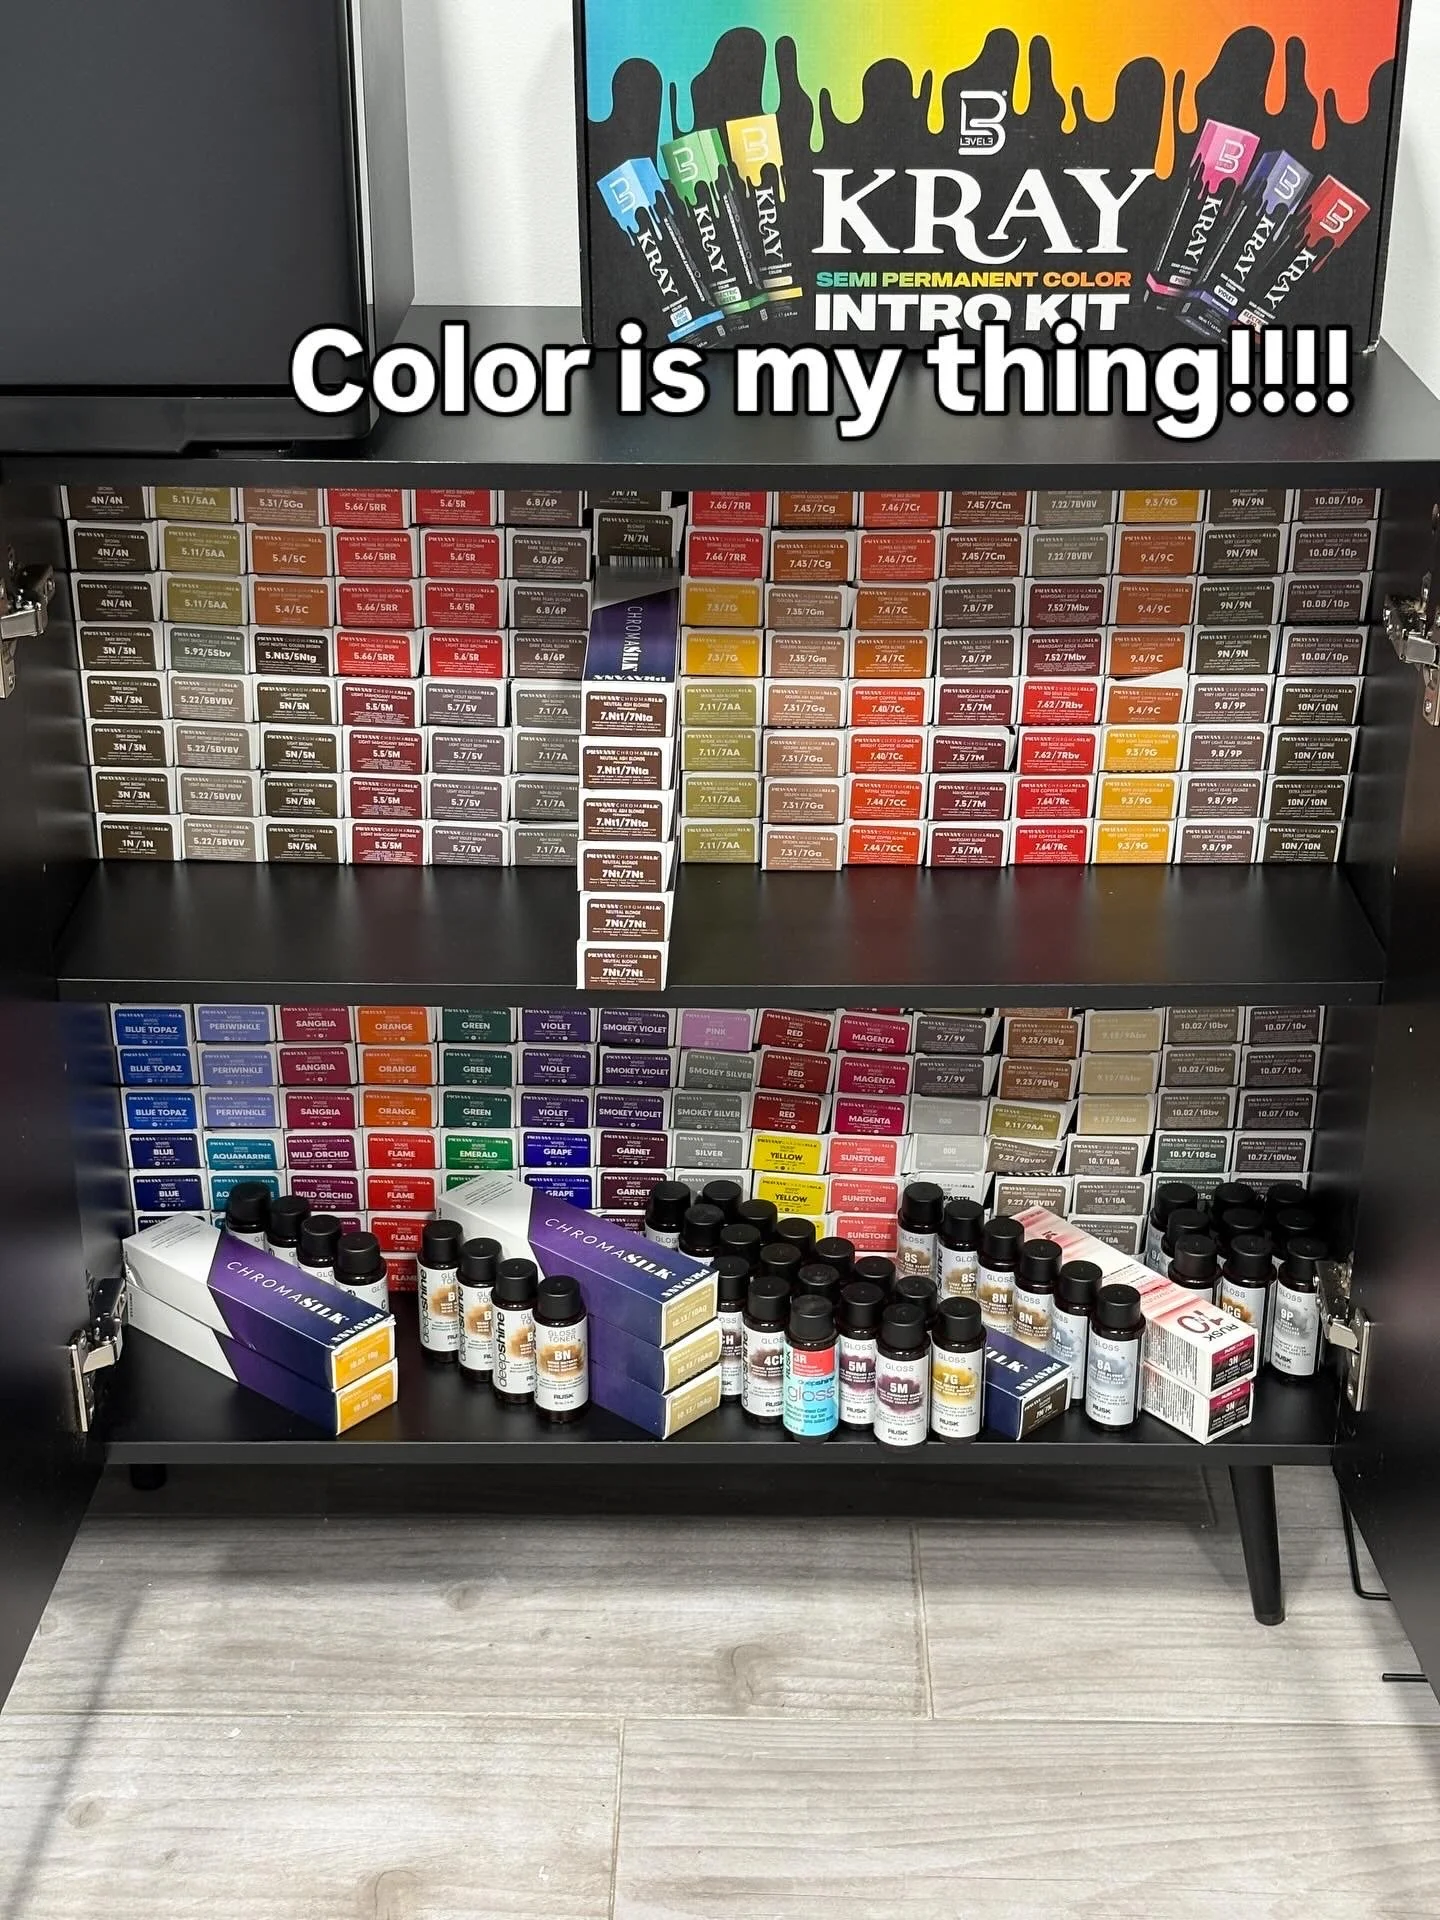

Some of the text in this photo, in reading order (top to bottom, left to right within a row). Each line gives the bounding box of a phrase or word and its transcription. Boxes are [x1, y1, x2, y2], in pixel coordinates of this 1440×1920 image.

[812, 168, 1155, 265] KRAY
[756, 186, 784, 260] KRAY
[1185, 195, 1223, 264] KRAY
[694, 204, 729, 274] KRAY
[1234, 215, 1276, 283] KRAY
[637, 229, 680, 296] KRAY
[816, 272, 1131, 287] SEMI PERMANENT COLOR
[1264, 247, 1317, 309] KRAY
[815, 294, 1129, 330] INTRO KIT
[1232, 498, 1264, 506] 9N/9N
[623, 534, 649, 543] 7N/7N
[97, 549, 129, 557] 4N/4N
[1226, 548, 1258, 557] 9N/9N
[533, 556, 564, 564] 6.8/6P
[1141, 553, 1174, 562] 9.4/9C
[101, 599, 132, 608] 4N/4N
[878, 606, 908, 615] 7.4/7C
[535, 653, 565, 661] 6.8/6P
[1217, 650, 1248, 658] 9N/9N
[699, 702, 741, 711] 7.11/7AA
[959, 703, 992, 712] 7.5/7M
[1214, 702, 1246, 710] 9.8/9P
[1298, 703, 1338, 712] 10N/10N
[285, 751, 315, 760] 5N/5N
[699, 748, 740, 757] 7.11/7AA
[1211, 749, 1242, 758] 9.8/9P
[1294, 751, 1334, 760] 10N/10N
[287, 842, 317, 850] 5N/5N
[699, 841, 740, 849] 7.11/7AA
[1202, 843, 1232, 852] 9.8/9P
[1281, 842, 1321, 850] 10N/10N
[210, 1023, 261, 1031] PERIWINKLE
[295, 1020, 336, 1028] SANGRIA
[375, 1023, 413, 1031] ORANGE
[462, 1022, 490, 1030] GREEN
[540, 1022, 571, 1030] VIOLET
[603, 1024, 667, 1033] SMOKEY VIOLET
[149, 1026, 178, 1034] TOPAZ
[706, 1028, 726, 1036] PINK
[787, 1029, 803, 1037] RED
[852, 1034, 894, 1044] MAGENTA
[379, 1065, 417, 1073] ORANGE
[463, 1066, 491, 1074] GREEN
[689, 1067, 752, 1079] SMOKEY SILVER
[853, 1075, 895, 1085] MAGENTA
[300, 1108, 341, 1116] SANGRIA
[538, 1109, 568, 1117] VIOLET
[779, 1110, 795, 1119] RED
[315, 1150, 349, 1158] ORCHID
[387, 1150, 416, 1158] FLAME
[543, 1148, 572, 1156] GRAPE
[616, 1147, 651, 1155] GARNET
[695, 1149, 723, 1157] SILVER
[771, 1153, 803, 1161] YELLOW
[840, 1154, 886, 1163] SUNSTONE
[775, 1193, 807, 1202] YELLOW
[842, 1195, 886, 1203] SUNSTONE
[545, 1218, 676, 1280] CHROMASILK
[905, 1253, 917, 1263] 8S
[226, 1261, 350, 1325] CHROMASILK
[992, 1294, 1007, 1303] 8N
[1280, 1309, 1293, 1320] 9P
[1203, 1323, 1239, 1341] RUSK
[496, 1313, 507, 1387] deepshine
[554, 1351, 571, 1360] BN
[794, 1355, 807, 1364] 3R
[938, 1354, 966, 1363] GLOSS
[848, 1362, 867, 1371] 5M
[885, 1363, 914, 1372] GLOSS
[1097, 1360, 1111, 1371] 8A
[943, 1373, 958, 1384] 7G
[890, 1383, 908, 1393] 5M
[787, 1386, 835, 1402] gloss
[939, 1418, 959, 1426] RUSK
